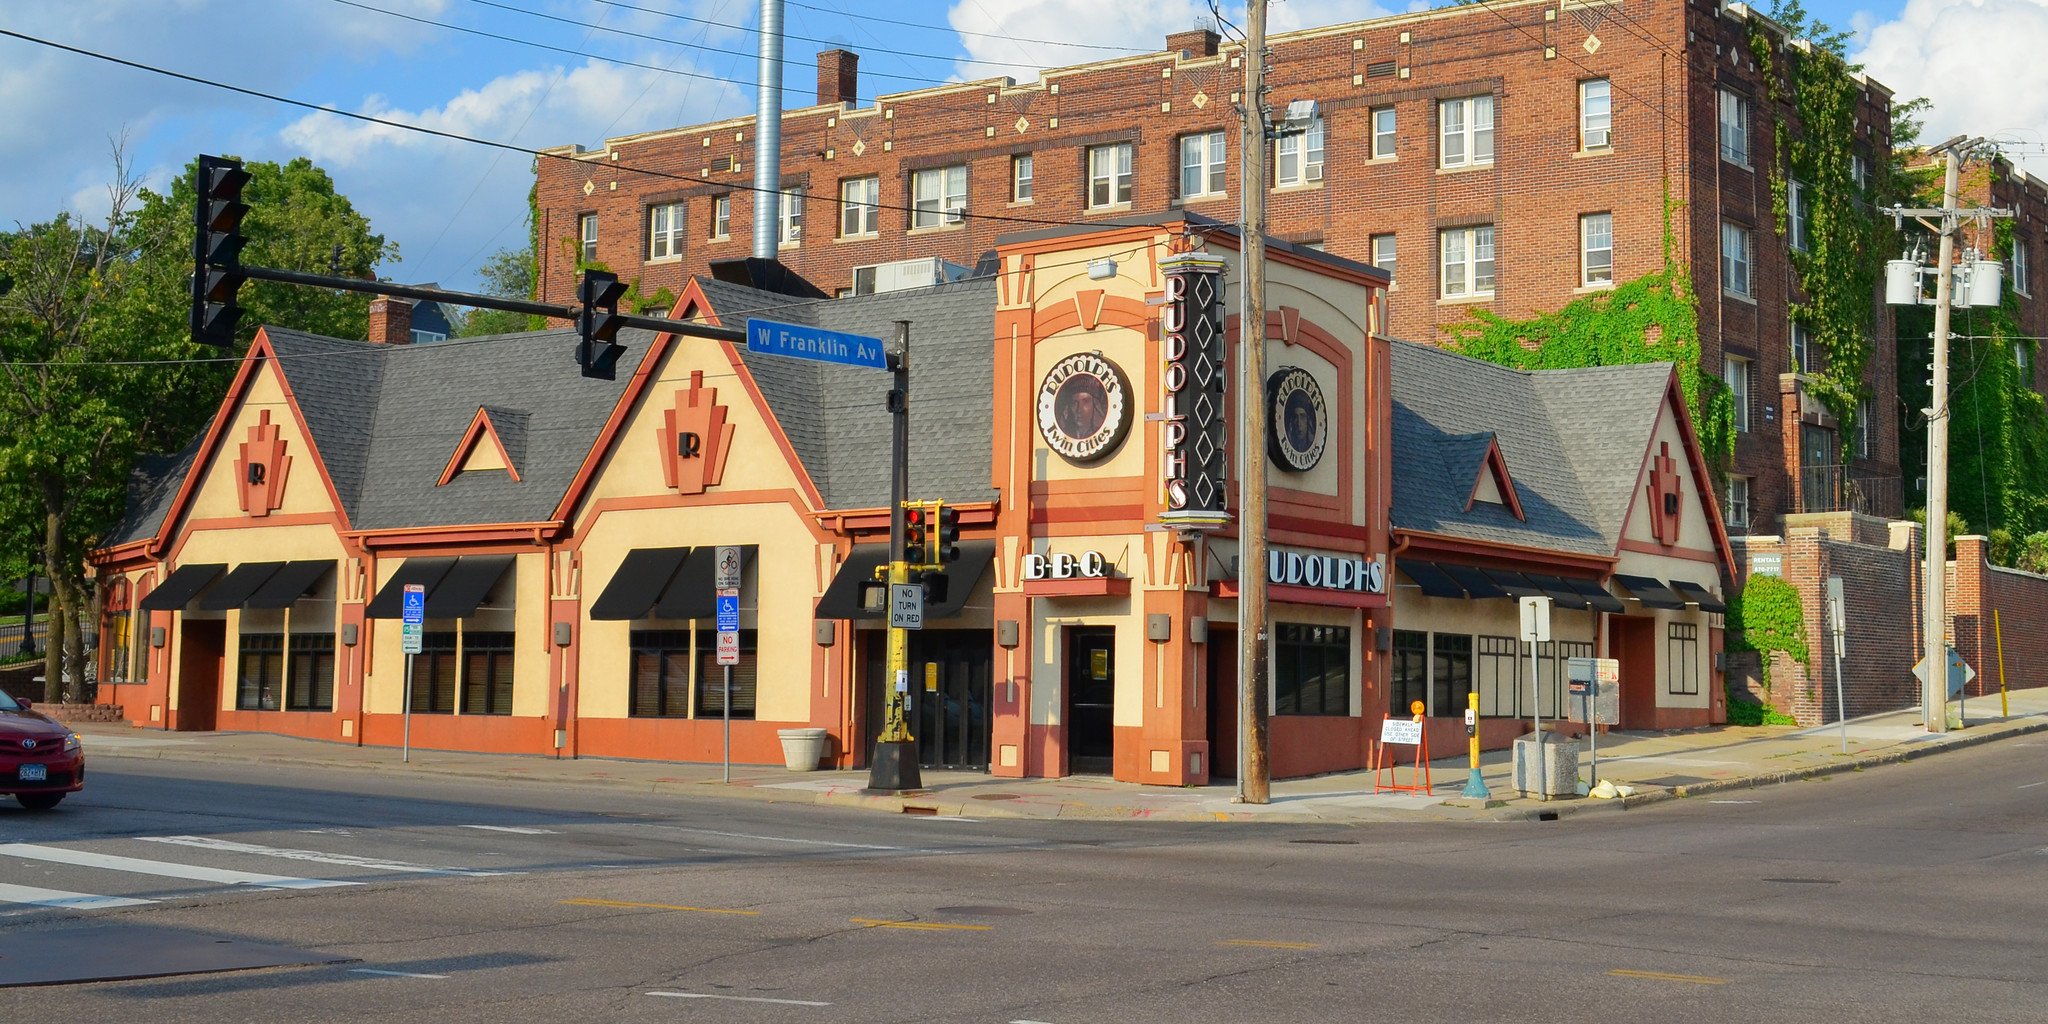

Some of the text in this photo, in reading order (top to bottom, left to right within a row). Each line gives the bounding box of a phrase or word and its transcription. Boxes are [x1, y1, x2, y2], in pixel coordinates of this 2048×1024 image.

[758, 327, 876, 361] W Franklin Av
[1046, 359, 1117, 396] RUDOLPHS
[1279, 375, 1320, 411] RUDOLPHS
[678, 432, 701, 459] R
[1047, 422, 1111, 453] Twin Cities
[1280, 436, 1320, 466] Twin Cities
[248, 462, 266, 486] R
[1025, 551, 1103, 579] B-B-Q
[1269, 550, 1383, 593] UDOLPHS
[899, 601, 917, 610] TURN
[902, 589, 913, 598] NO
[894, 613, 920, 623] ON RED
[723, 636, 733, 644] NO
